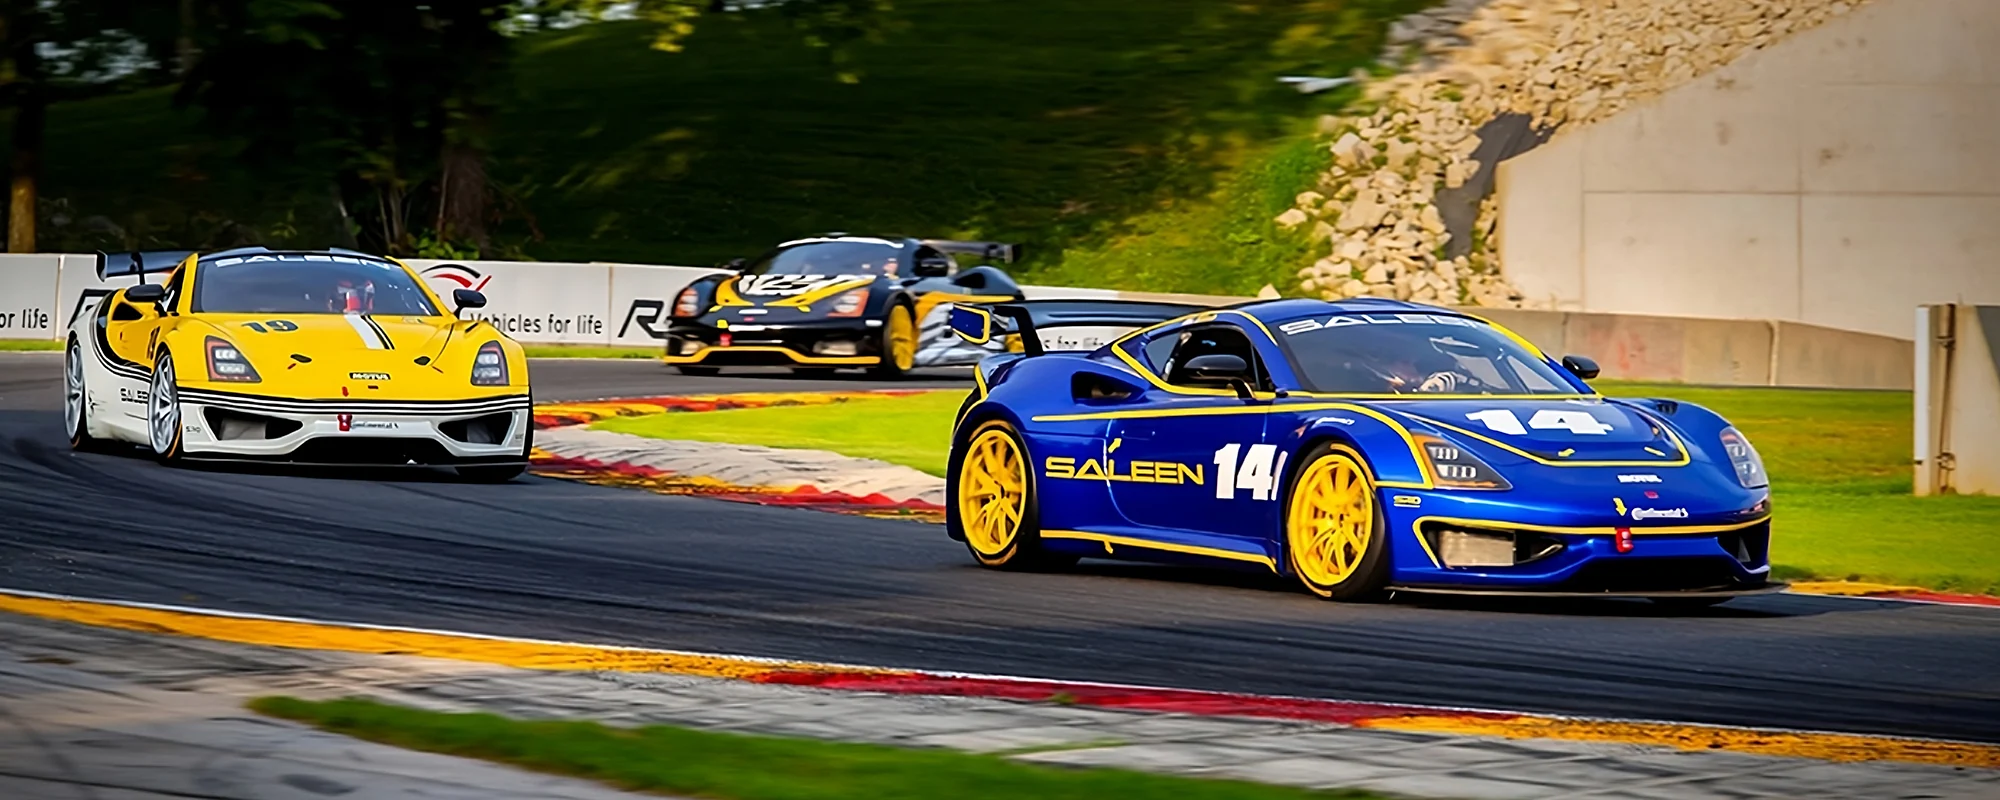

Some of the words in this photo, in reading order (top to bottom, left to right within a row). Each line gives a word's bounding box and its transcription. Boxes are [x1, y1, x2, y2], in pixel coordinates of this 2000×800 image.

[22, 308, 48, 328] life
[241, 320, 299, 333] 19
[549, 313, 571, 333] for
[577, 315, 602, 335] life
[1464, 409, 1614, 436] 14
[1045, 456, 1204, 485] SALEEN
[1213, 443, 1288, 501] 14
